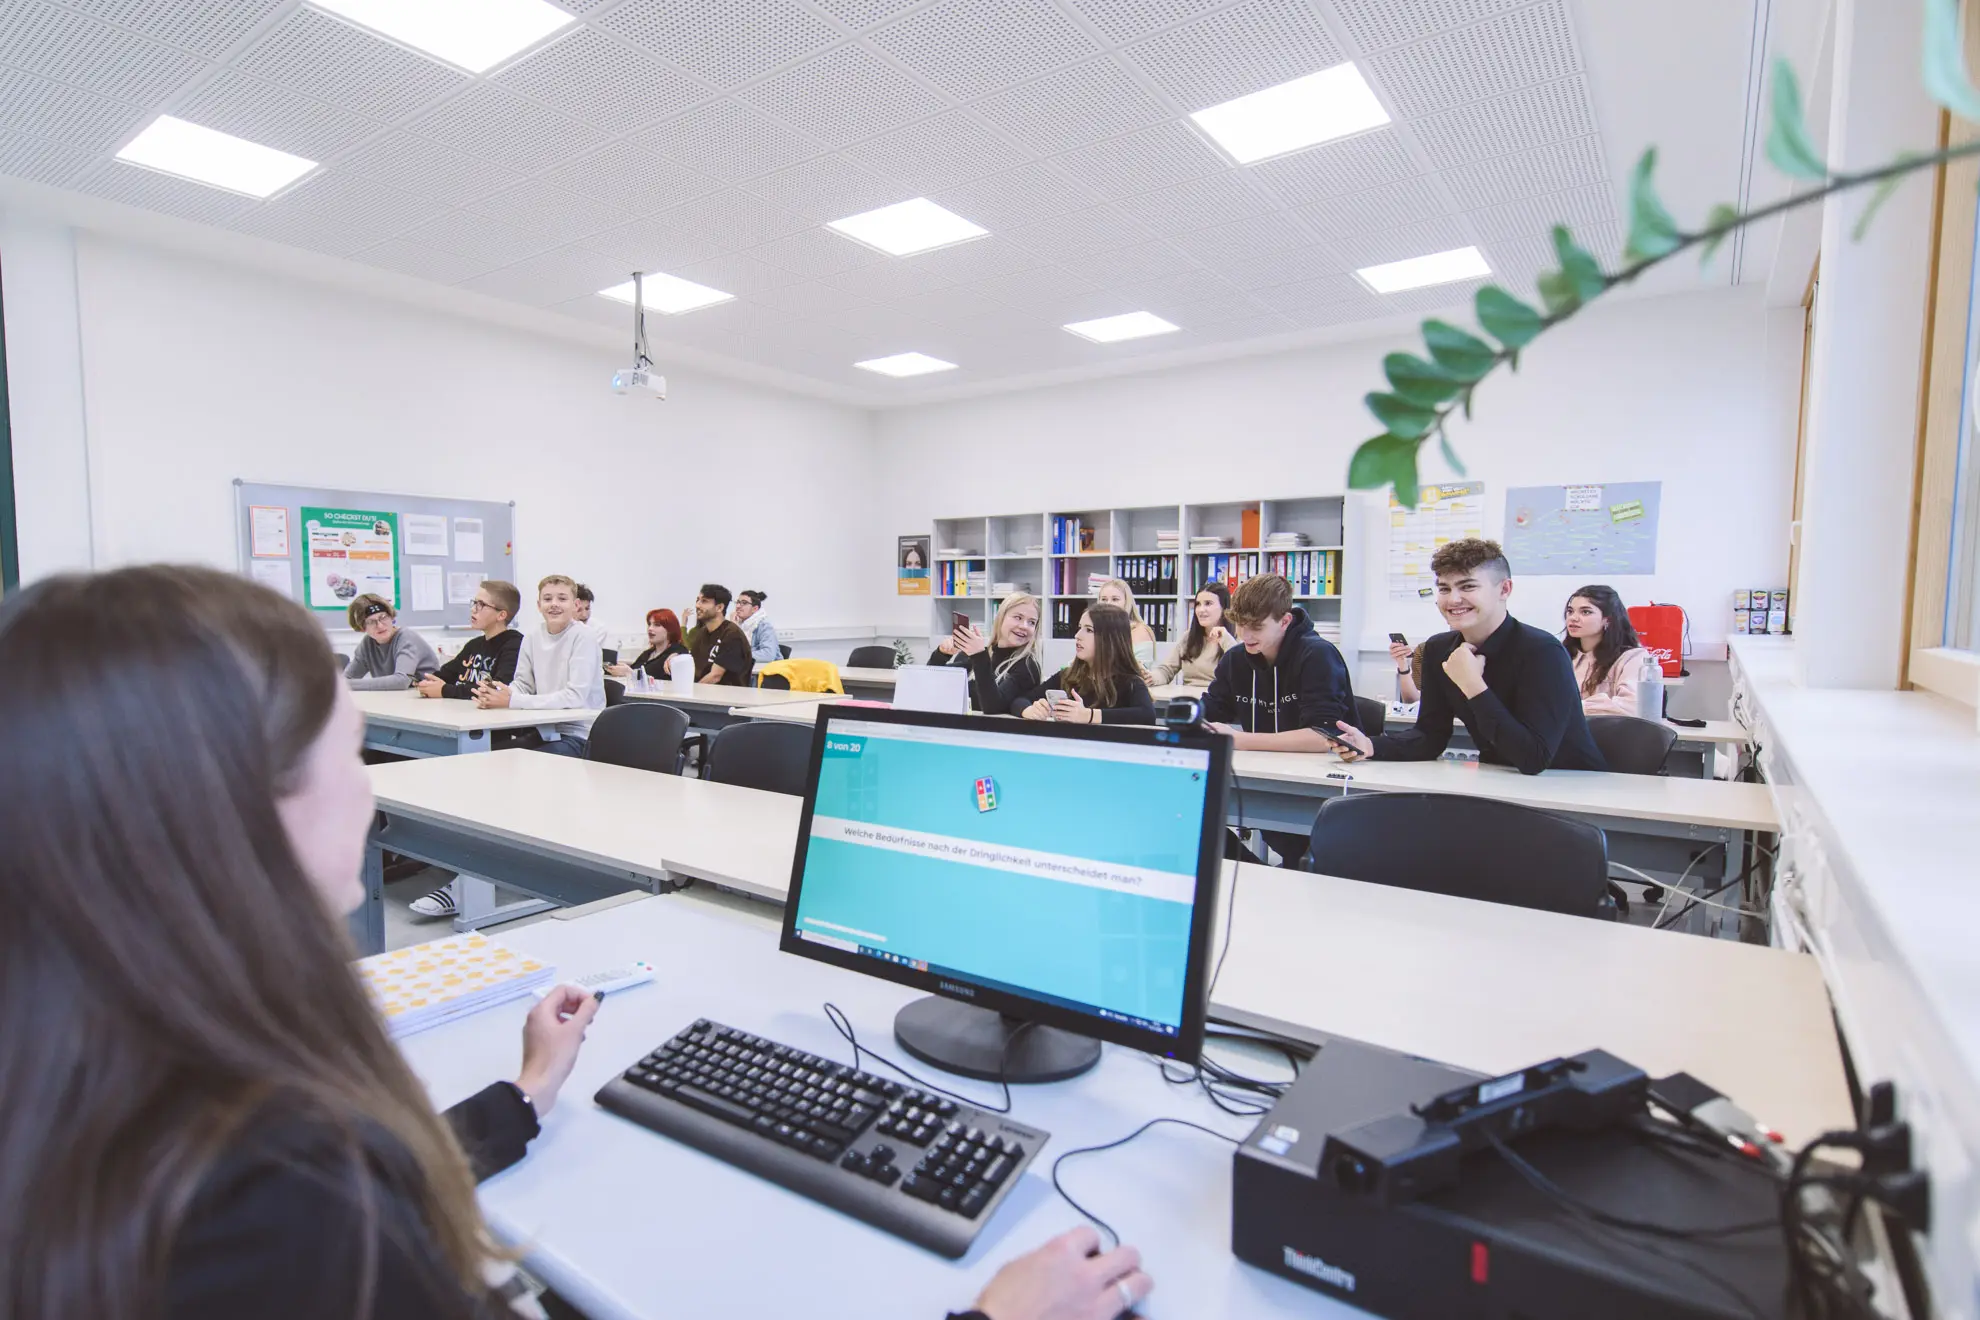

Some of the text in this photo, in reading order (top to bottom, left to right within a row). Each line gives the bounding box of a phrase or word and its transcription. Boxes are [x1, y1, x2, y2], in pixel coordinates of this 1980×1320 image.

[834, 742, 849, 751] von
[850, 743, 861, 752] 20
[844, 826, 874, 839] Welche
[928, 842, 949, 853] nach
[952, 845, 968, 855] der
[969, 848, 1031, 867] Dringlichkeit
[1034, 860, 1108, 880] unterscheidet
[1110, 874, 1143, 886] man?
